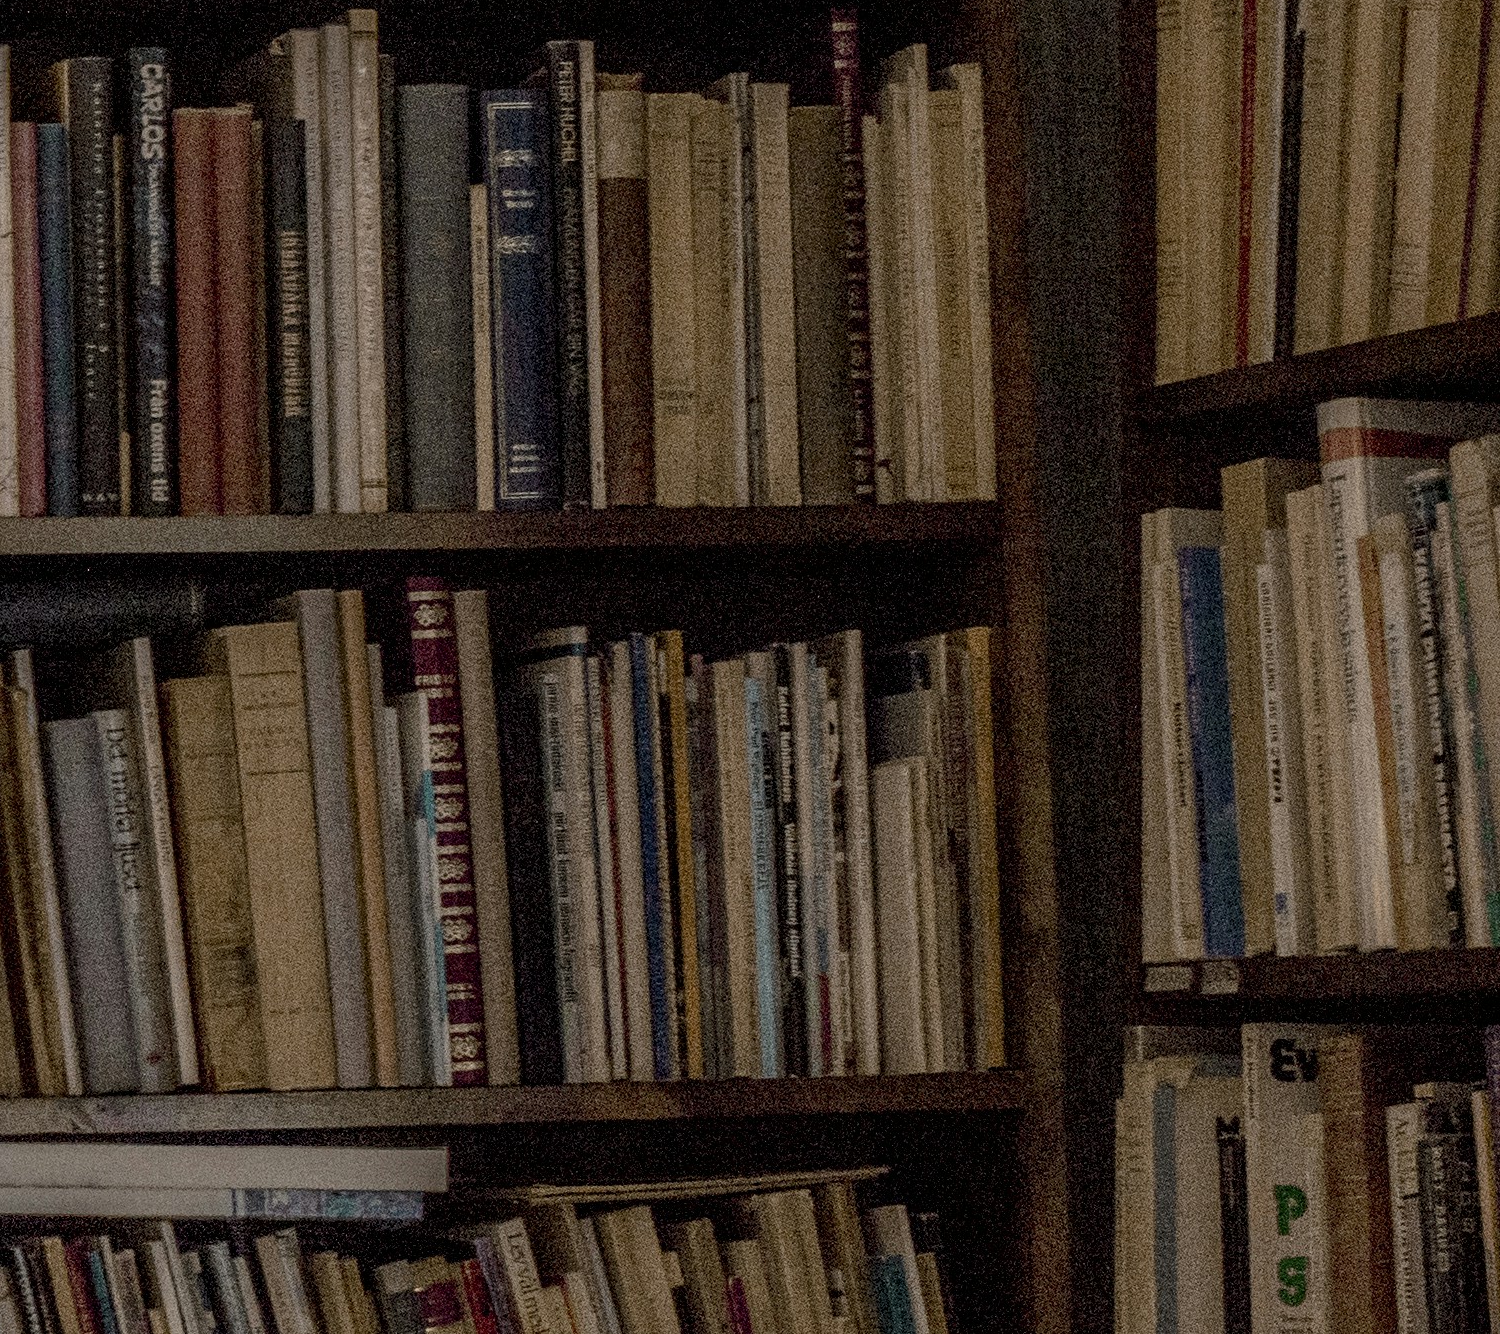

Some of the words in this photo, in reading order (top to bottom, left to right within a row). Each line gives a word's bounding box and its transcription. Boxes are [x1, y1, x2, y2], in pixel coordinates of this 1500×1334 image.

[558, 62, 575, 103] PETER
[140, 63, 164, 159] CARLOS
[560, 107, 576, 164] HUCHEL
[150, 378, 169, 418] Från
[151, 422, 166, 473] oxens
[152, 477, 169, 503] tid
[105, 726, 128, 760] Det
[113, 841, 141, 894] ljuset
